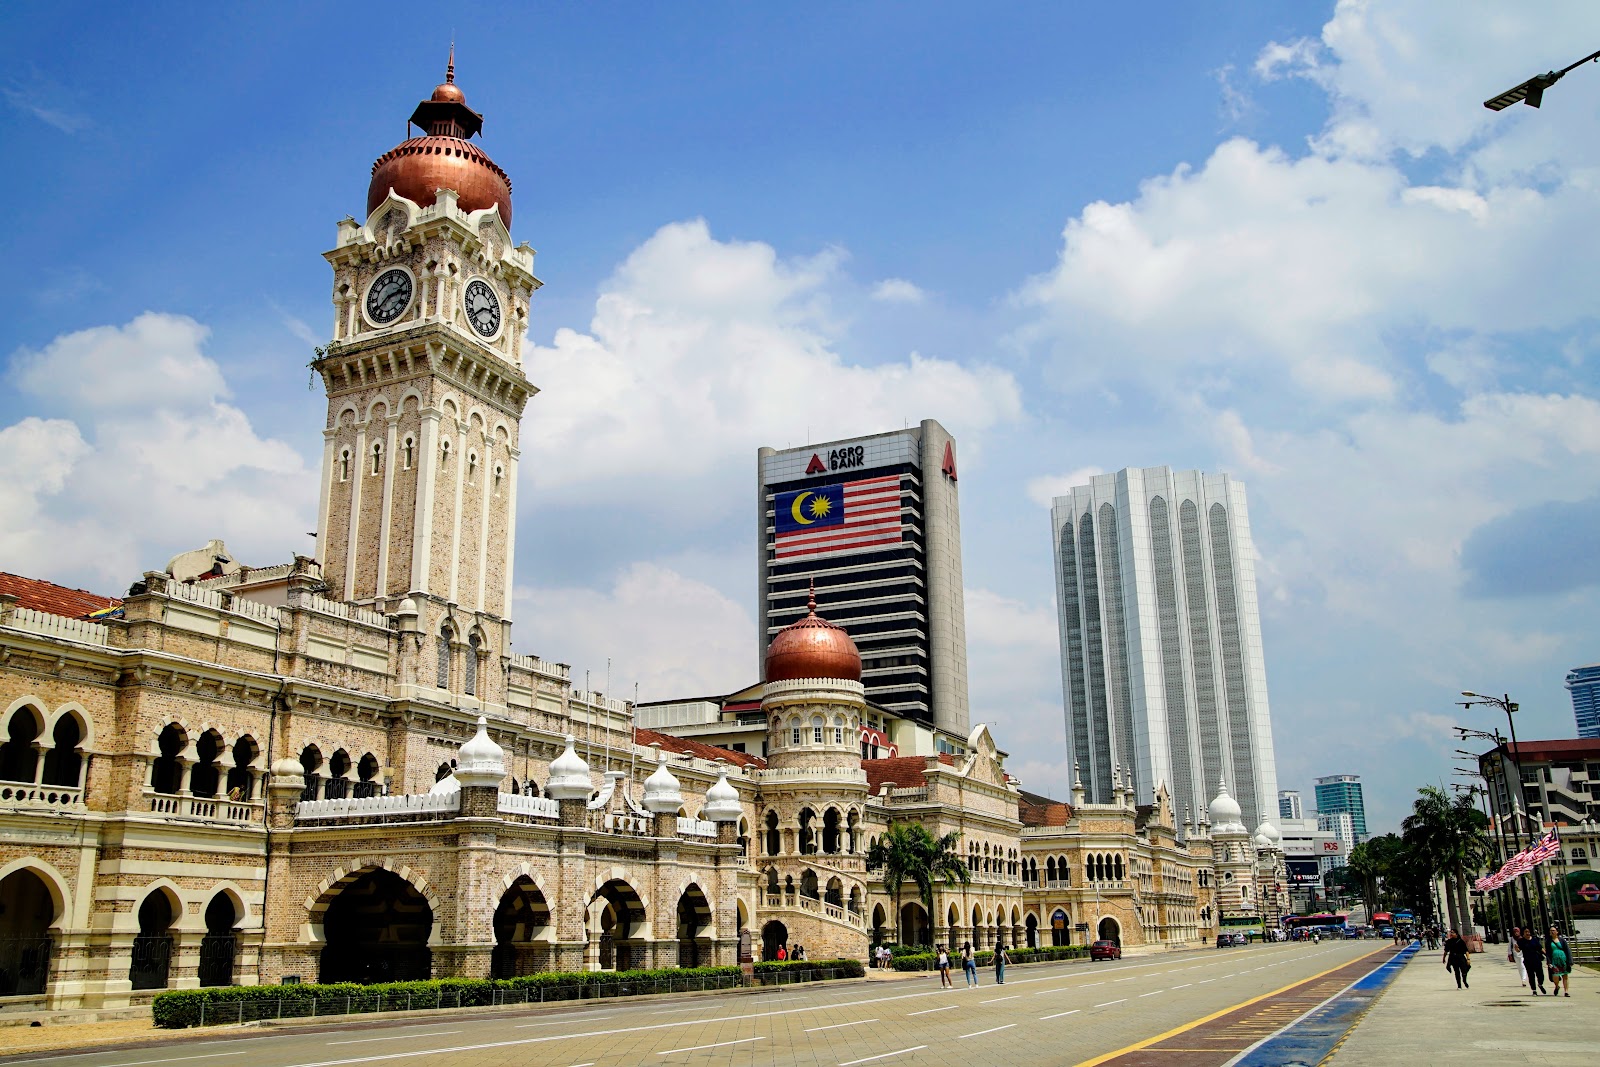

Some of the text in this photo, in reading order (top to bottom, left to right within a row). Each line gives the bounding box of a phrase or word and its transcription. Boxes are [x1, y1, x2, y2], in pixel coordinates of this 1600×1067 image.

[830, 445, 864, 460] AGRO
[831, 455, 864, 470] BANK
[1324, 842, 1338, 850] POS
